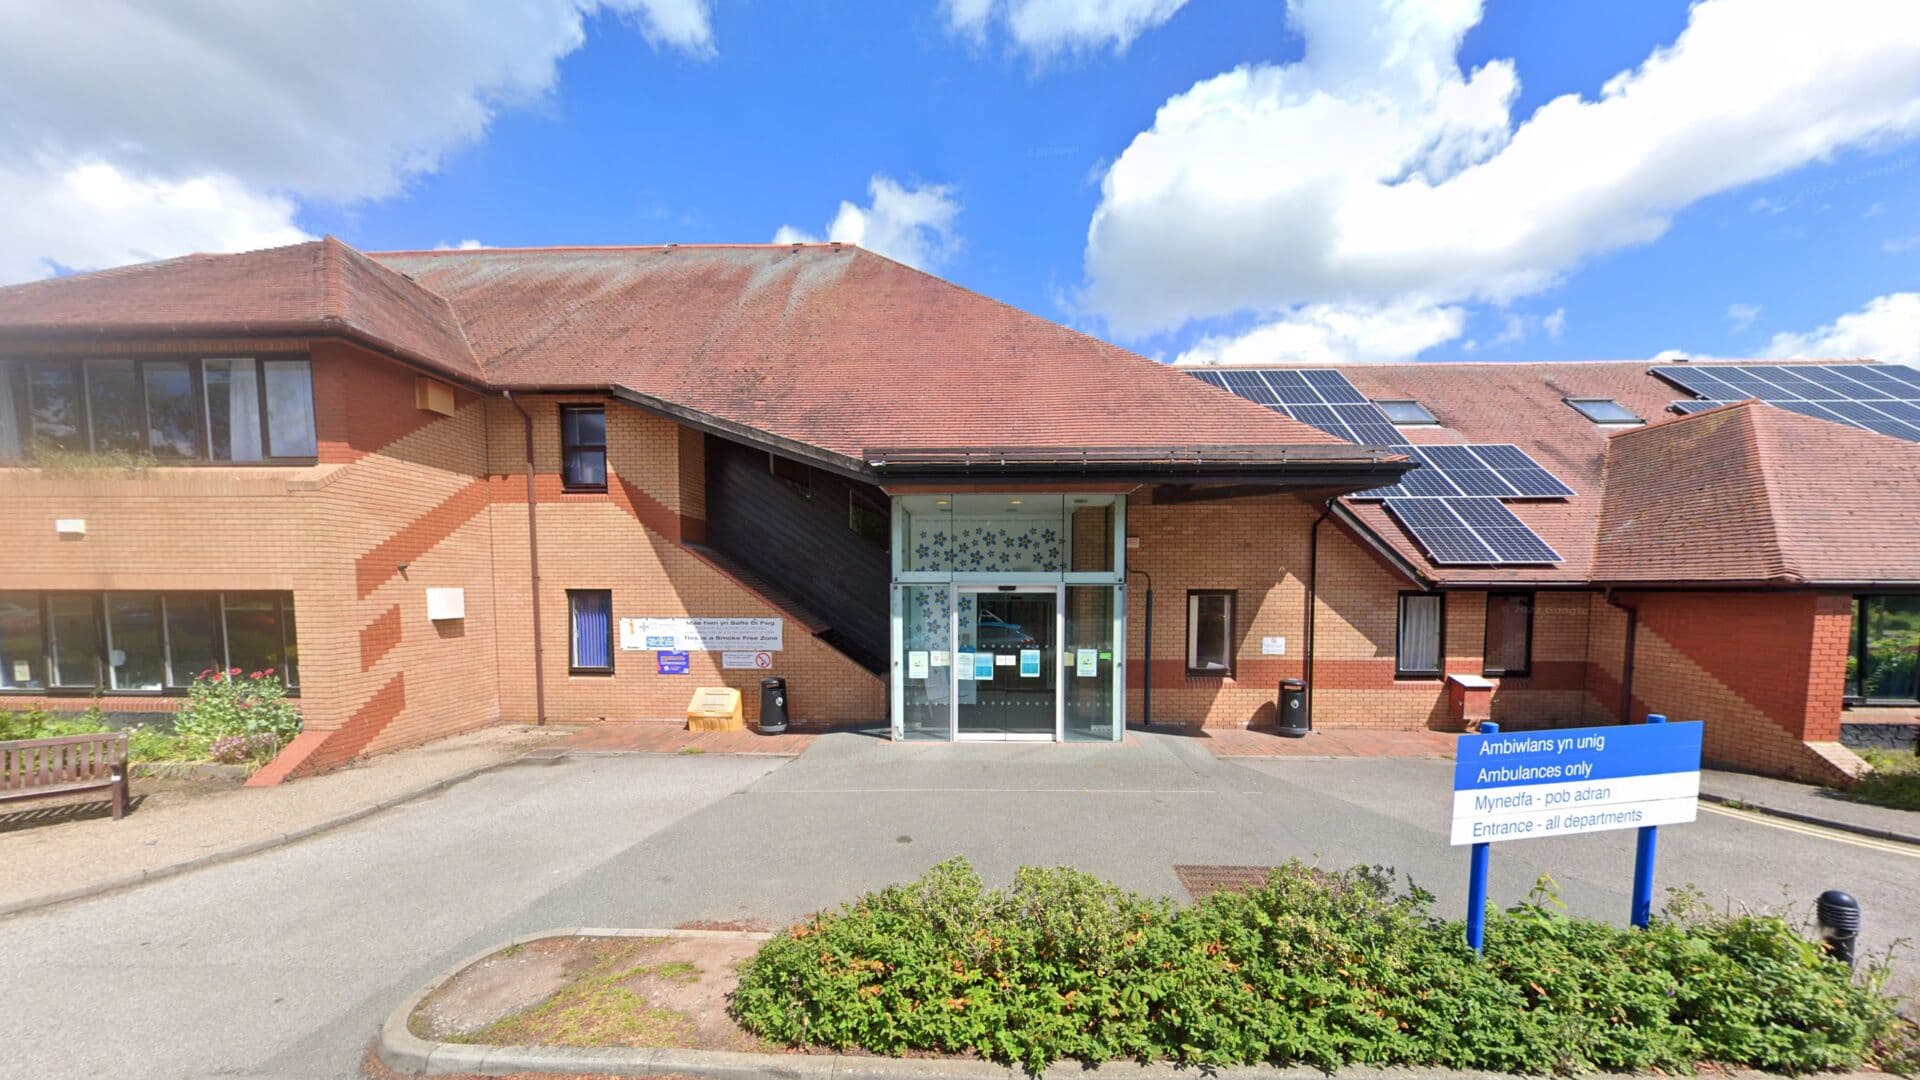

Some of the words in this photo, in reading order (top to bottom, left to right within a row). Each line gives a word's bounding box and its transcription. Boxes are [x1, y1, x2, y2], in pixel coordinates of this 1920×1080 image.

[1479, 736, 1554, 756] Ambiwlans
[1557, 739, 1573, 754] yn
[1577, 734, 1605, 751] unig
[1477, 765, 1562, 783] Ambulances
[1565, 760, 1593, 778] only
[1475, 792, 1533, 813] Mynedfa
[1545, 789, 1571, 807] pob
[1574, 786, 1610, 801] adran
[1473, 820, 1533, 837] Entrance
[1545, 815, 1560, 830] all
[1564, 809, 1643, 828] departments
